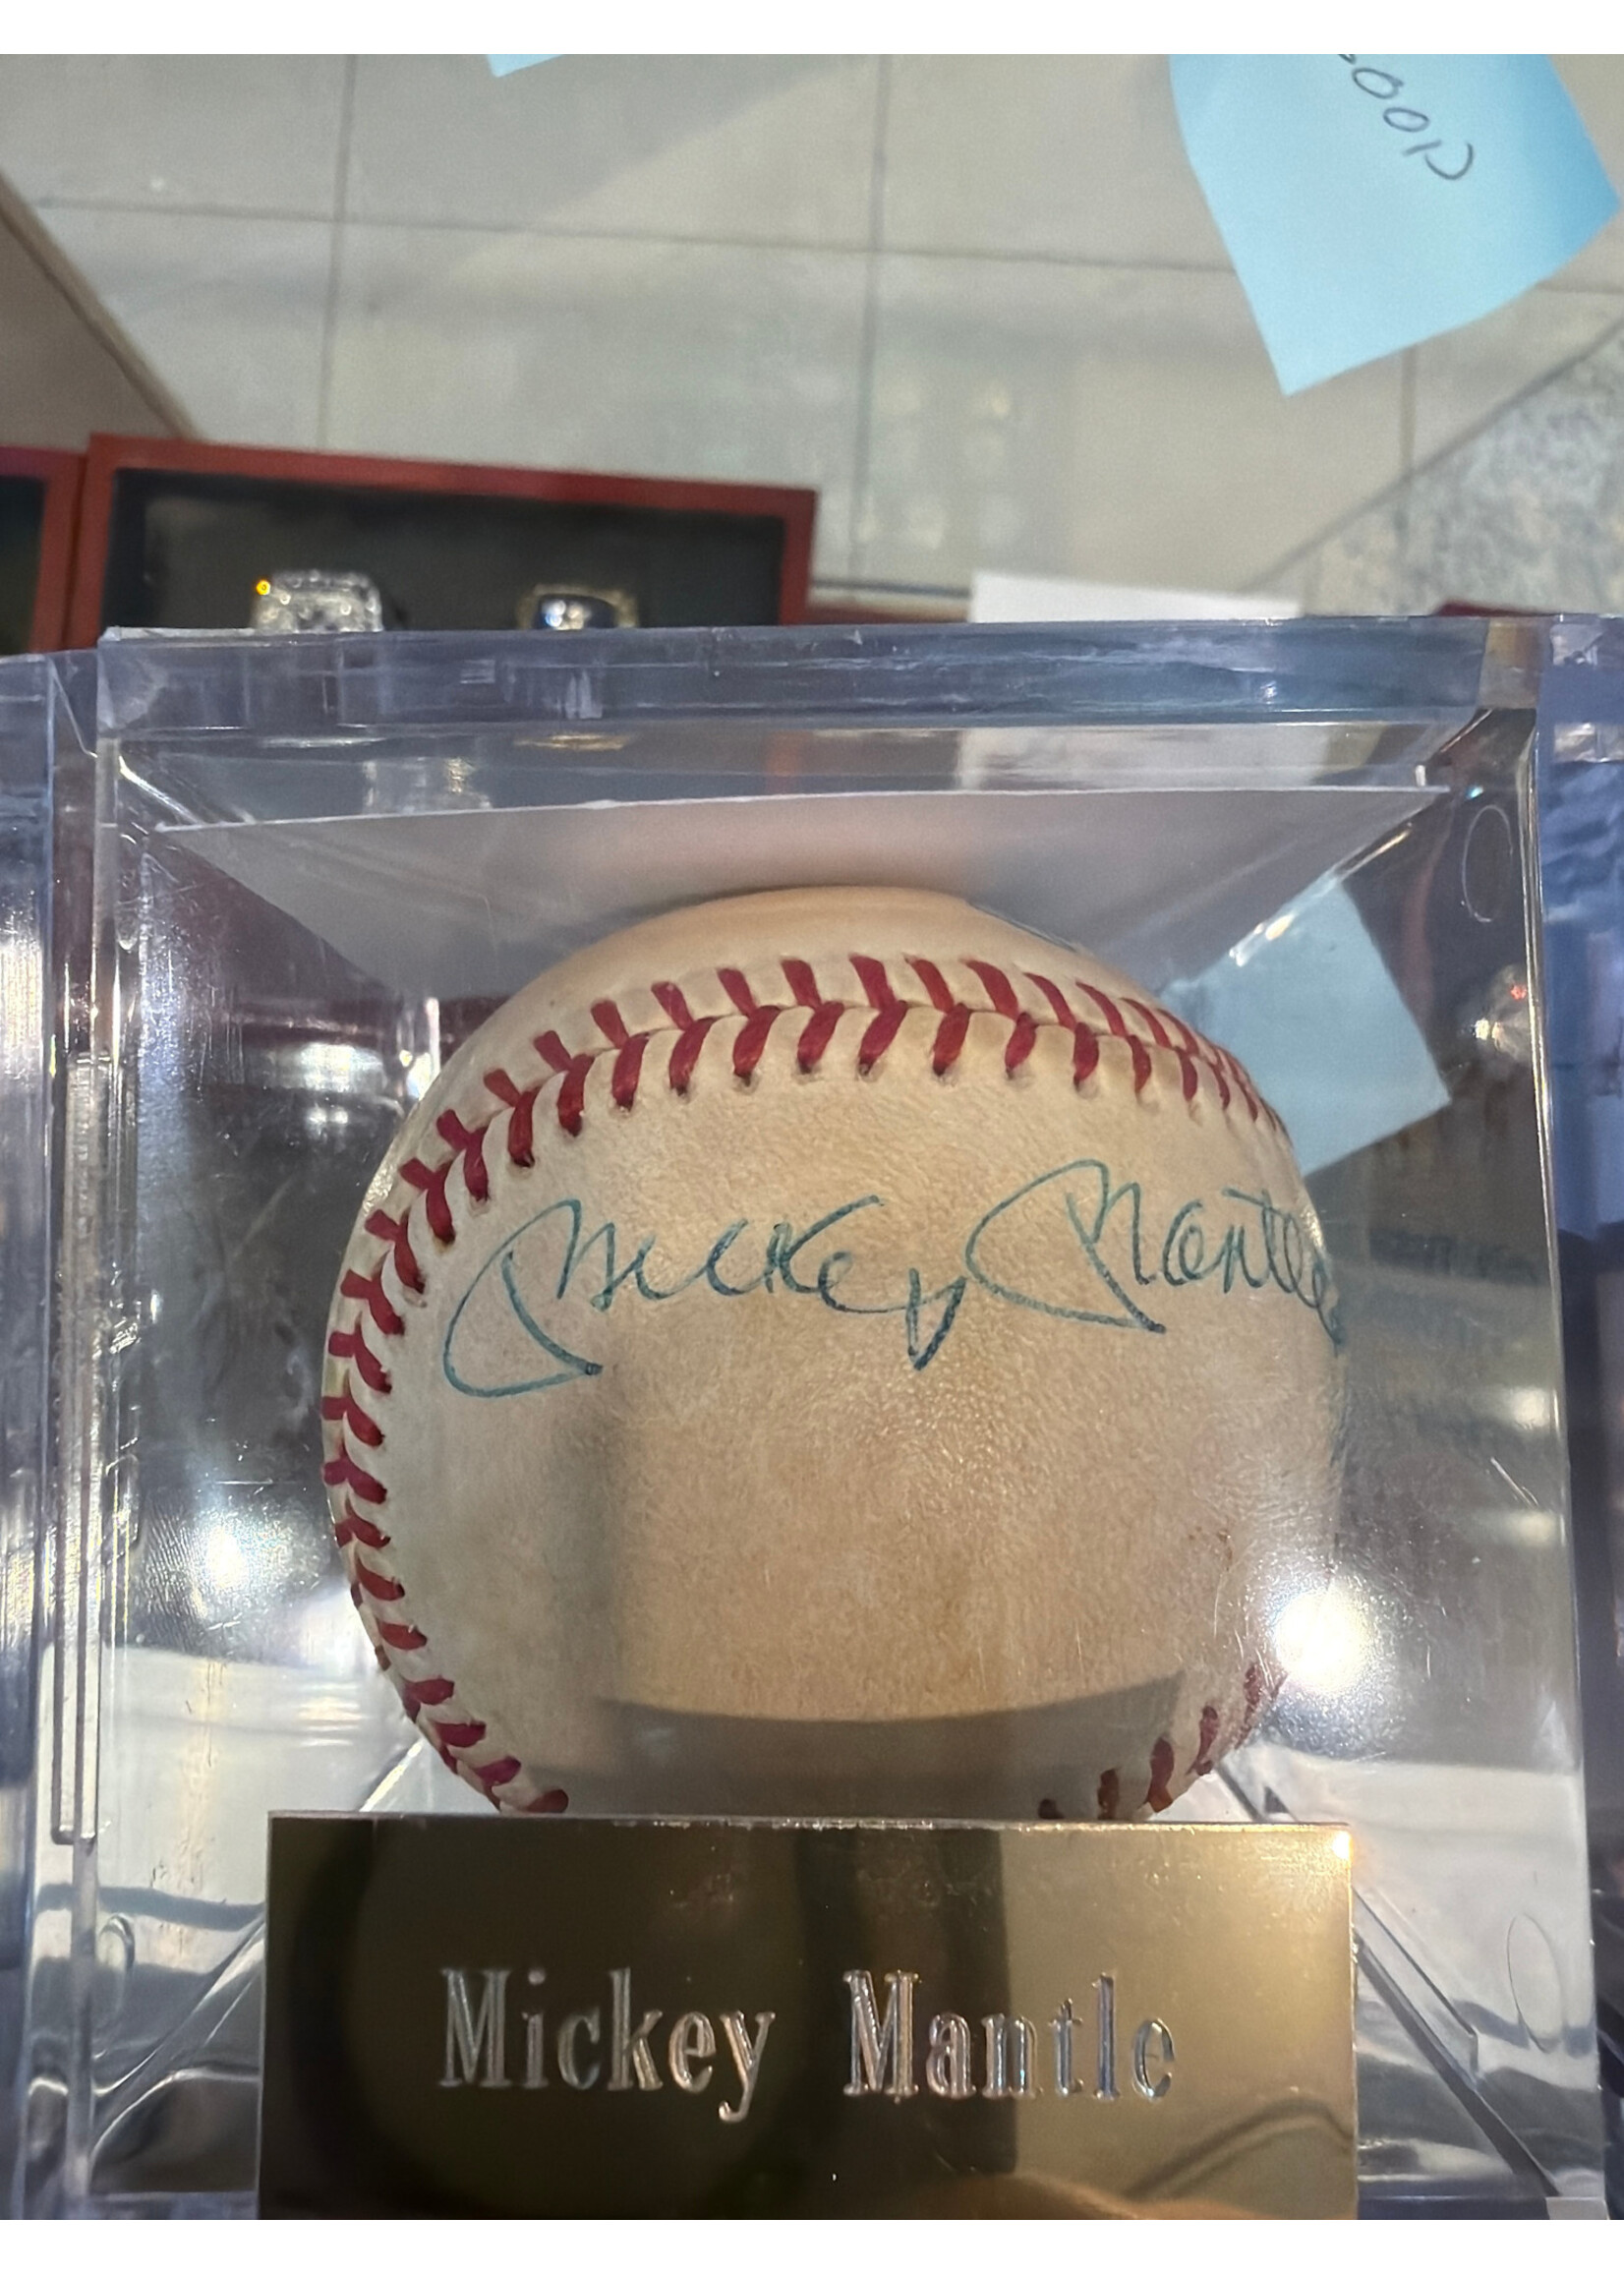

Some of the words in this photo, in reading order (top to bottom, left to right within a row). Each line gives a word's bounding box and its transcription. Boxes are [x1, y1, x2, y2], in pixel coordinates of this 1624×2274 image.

[442, 1196, 969, 1399] Mickey
[964, 1158, 1345, 1347] Mantle
[436, 1966, 778, 2124] Mickey
[841, 1968, 1177, 2102] Mantle
